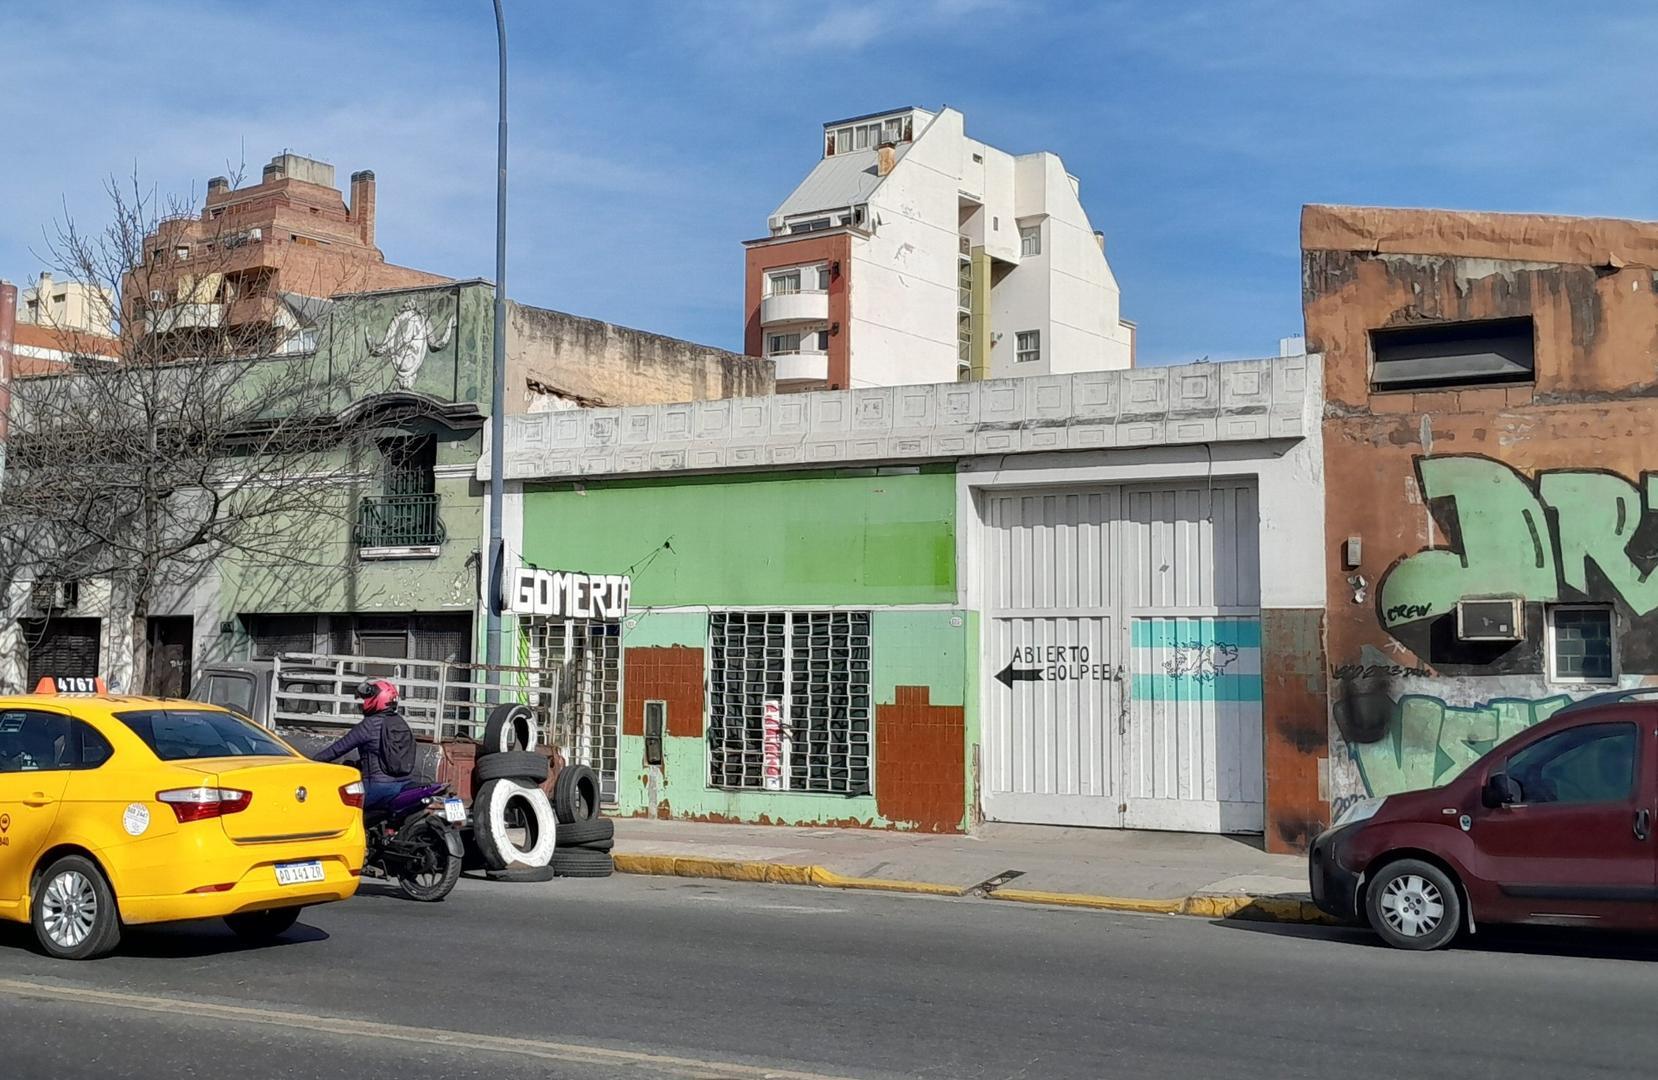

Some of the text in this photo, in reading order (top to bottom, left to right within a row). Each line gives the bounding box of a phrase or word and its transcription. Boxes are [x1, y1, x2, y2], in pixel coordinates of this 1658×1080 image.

[512, 567, 631, 618] GOMERIA
[1387, 602, 1432, 621] CREW
[1012, 646, 1089, 663] ABIERTO
[1047, 664, 1111, 681] GOLPEE
[58, 677, 94, 692] 4767
